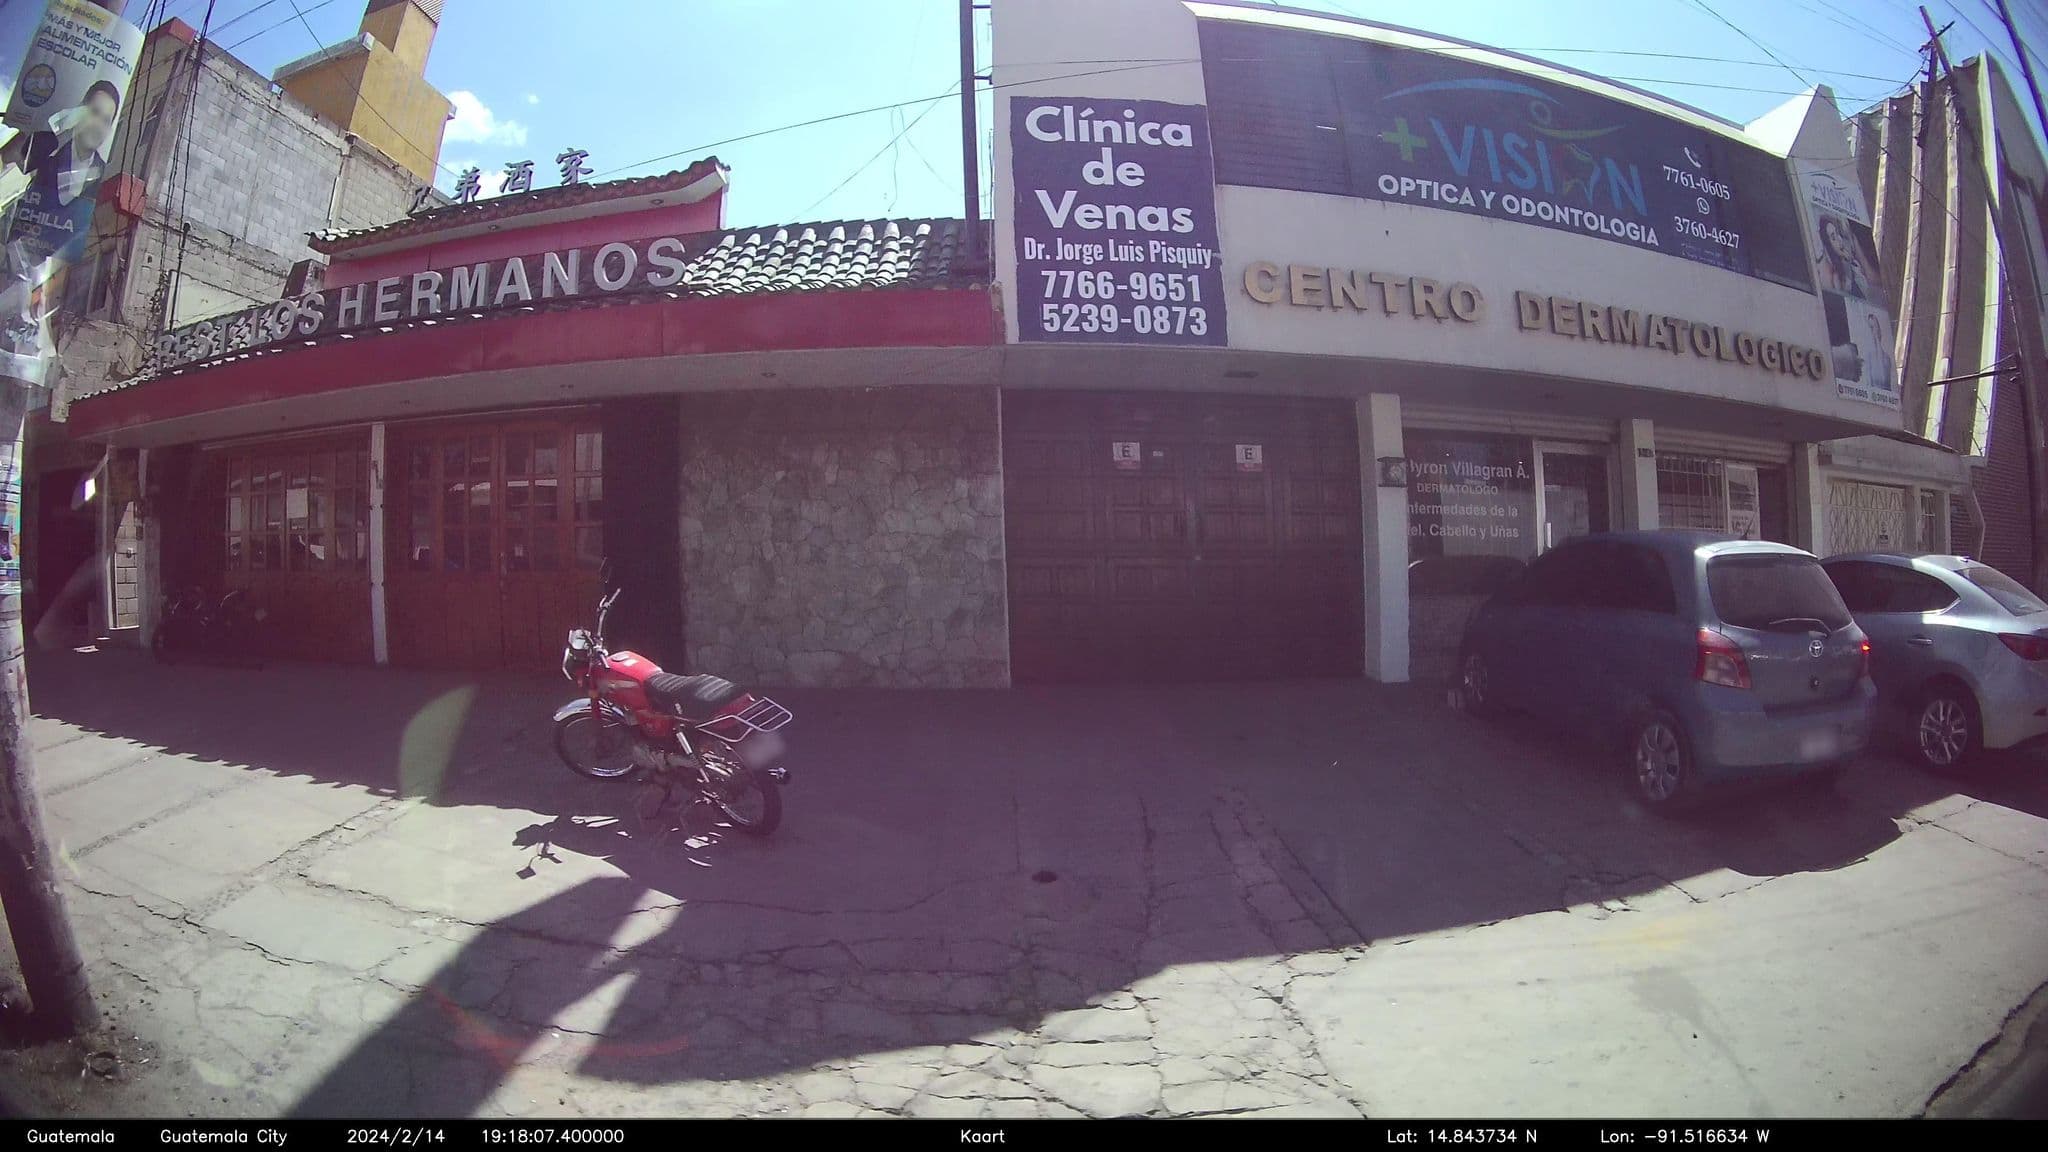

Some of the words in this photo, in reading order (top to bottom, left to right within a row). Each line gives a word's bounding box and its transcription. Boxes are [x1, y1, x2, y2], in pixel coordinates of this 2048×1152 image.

[37, 37, 97, 70] ESCOLAR
[43, 25, 133, 75] ALIMENTACIÓN
[76, 24, 85, 33] Y
[84, 27, 121, 52] MEJOR
[1025, 105, 1193, 147] Clínica
[1082, 147, 1146, 187] de
[1662, 165, 1731, 200] 7761-0605
[1034, 189, 1195, 233] Venas
[1378, 174, 1477, 207] OPTICA
[1480, 189, 1496, 210] Y
[1501, 194, 1660, 246] ODONTOLOGIA
[1674, 216, 1740, 249] 3760-4627
[1023, 236, 1051, 261] Dr.
[1056, 237, 1104, 266] Jorge
[1108, 238, 1145, 263] Luis
[1149, 240, 1212, 269] Pisquiy
[247, 293, 326, 348] LOS
[336, 237, 688, 330] HERMANOS
[1041, 270, 1201, 302] 7766-9651
[1042, 303, 1208, 336] 5239-0873
[1243, 261, 1485, 323] CENTRO
[1515, 290, 1827, 383] DERMATOLOGICO
[1452, 460, 1513, 480] Villagran
[1408, 503, 1487, 517] nfermedades
[1489, 504, 1505, 517] de
[1508, 505, 1519, 517] la
[1429, 523, 1477, 537] Cabello
[1480, 527, 1488, 540] y
